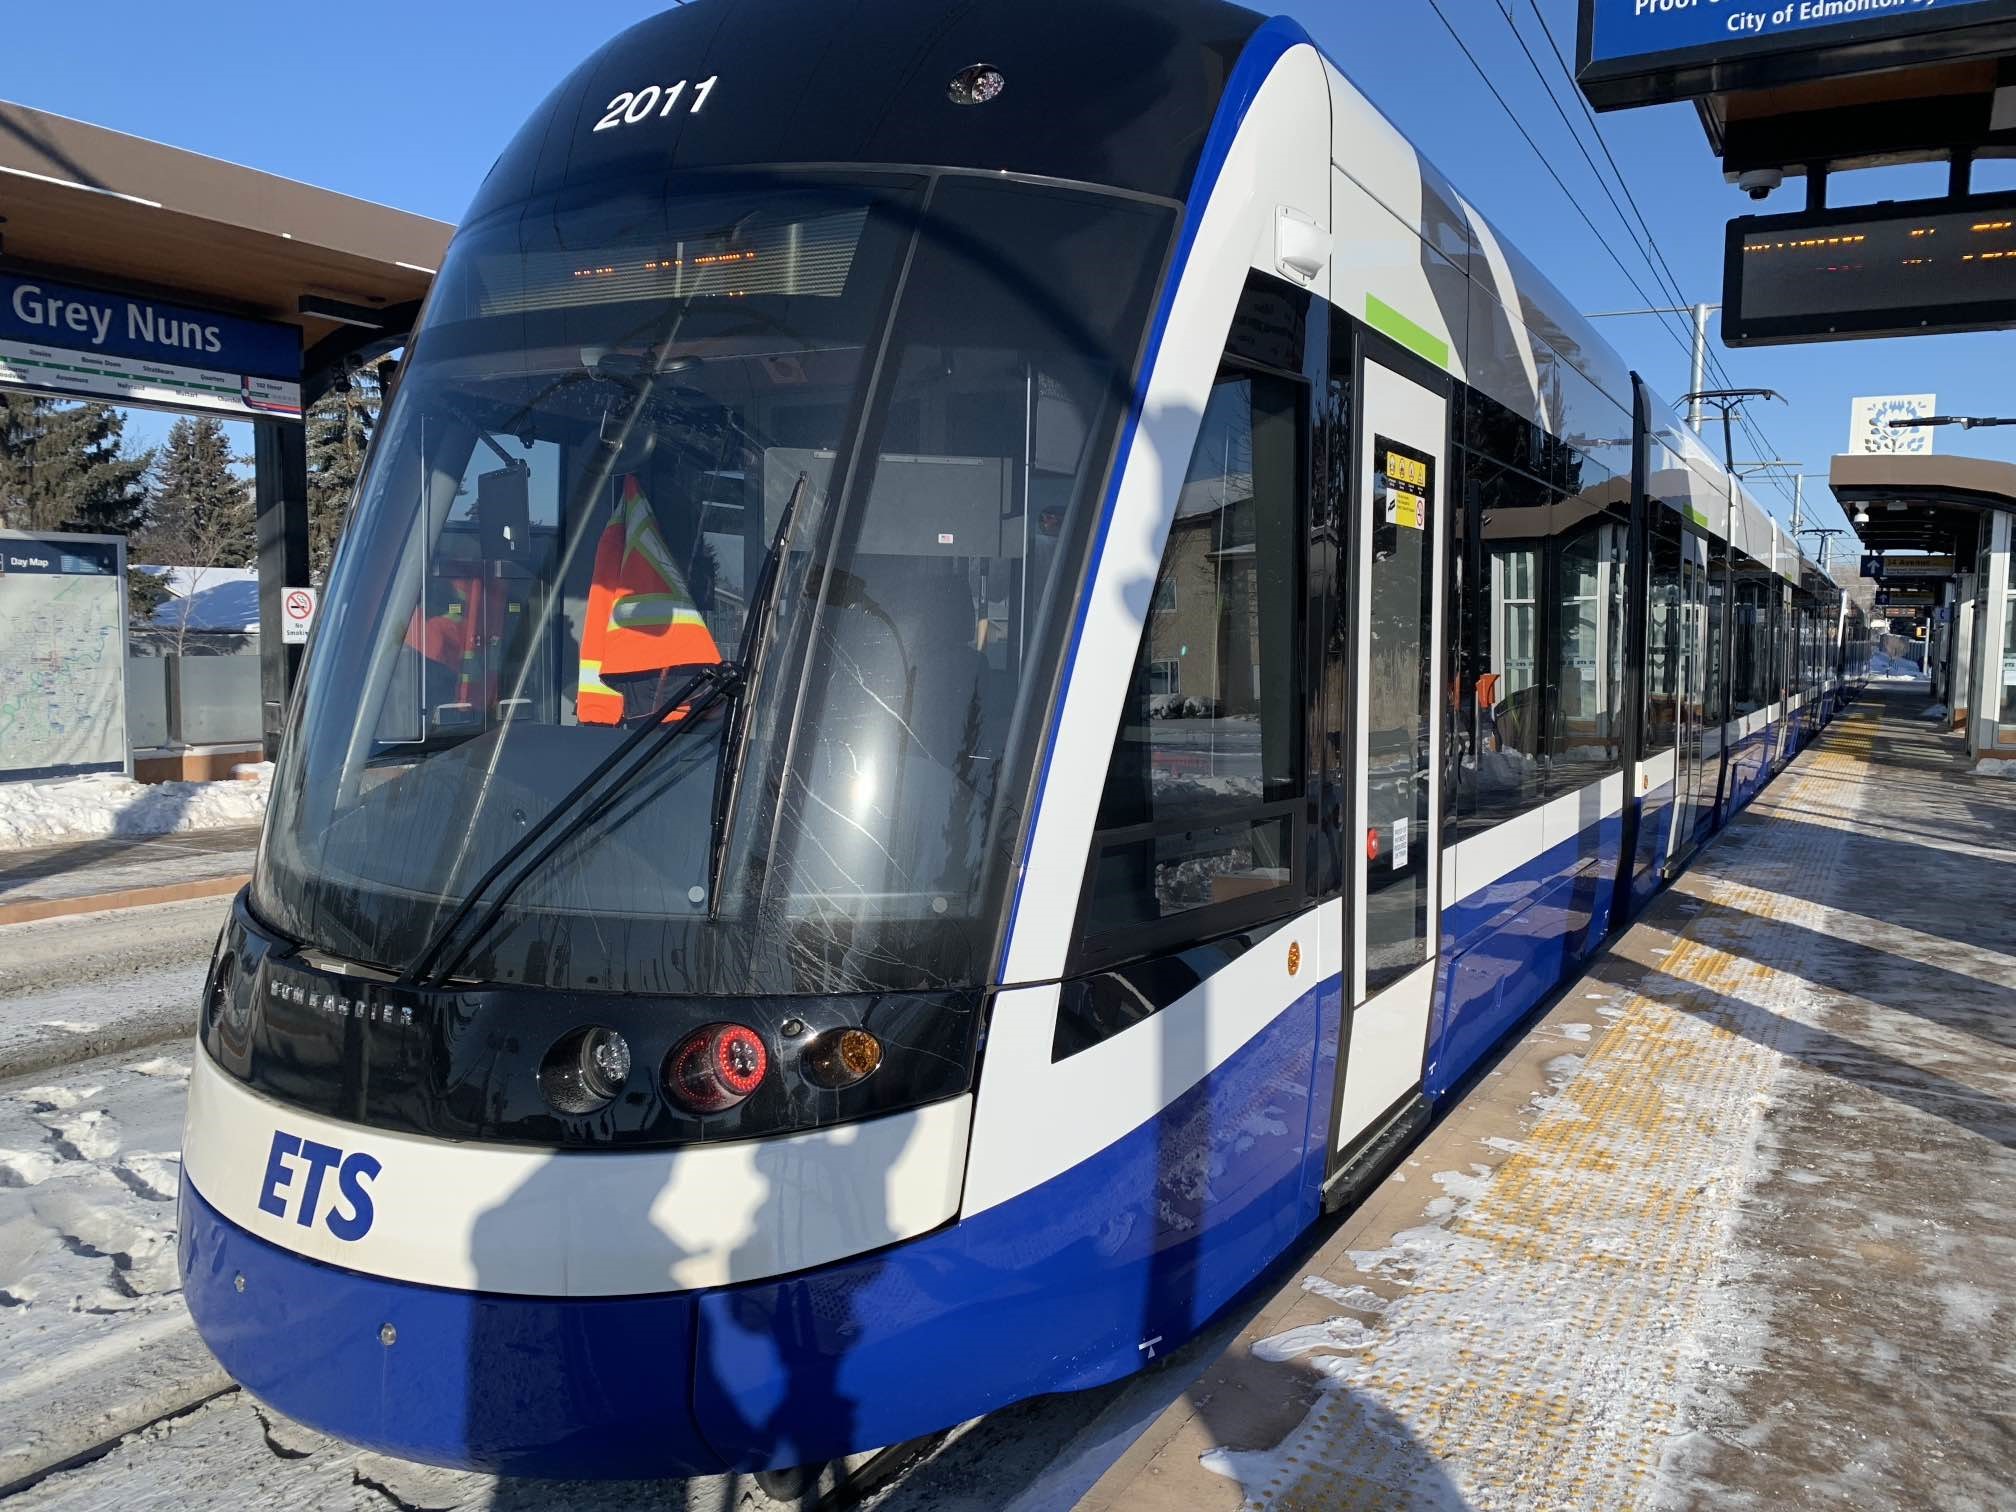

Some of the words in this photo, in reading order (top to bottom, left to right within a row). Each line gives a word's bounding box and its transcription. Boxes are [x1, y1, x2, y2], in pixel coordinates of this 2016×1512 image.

[1727, 12, 1766, 32] City
[1771, 3, 1794, 24] of
[592, 75, 718, 132] 2011
[12, 284, 112, 344] Grey
[127, 303, 222, 353] Nuns
[10, 557, 28, 568] Day
[29, 557, 49, 568] Map
[271, 979, 413, 1026] BOMBARDIER
[257, 1129, 383, 1242] ETS
